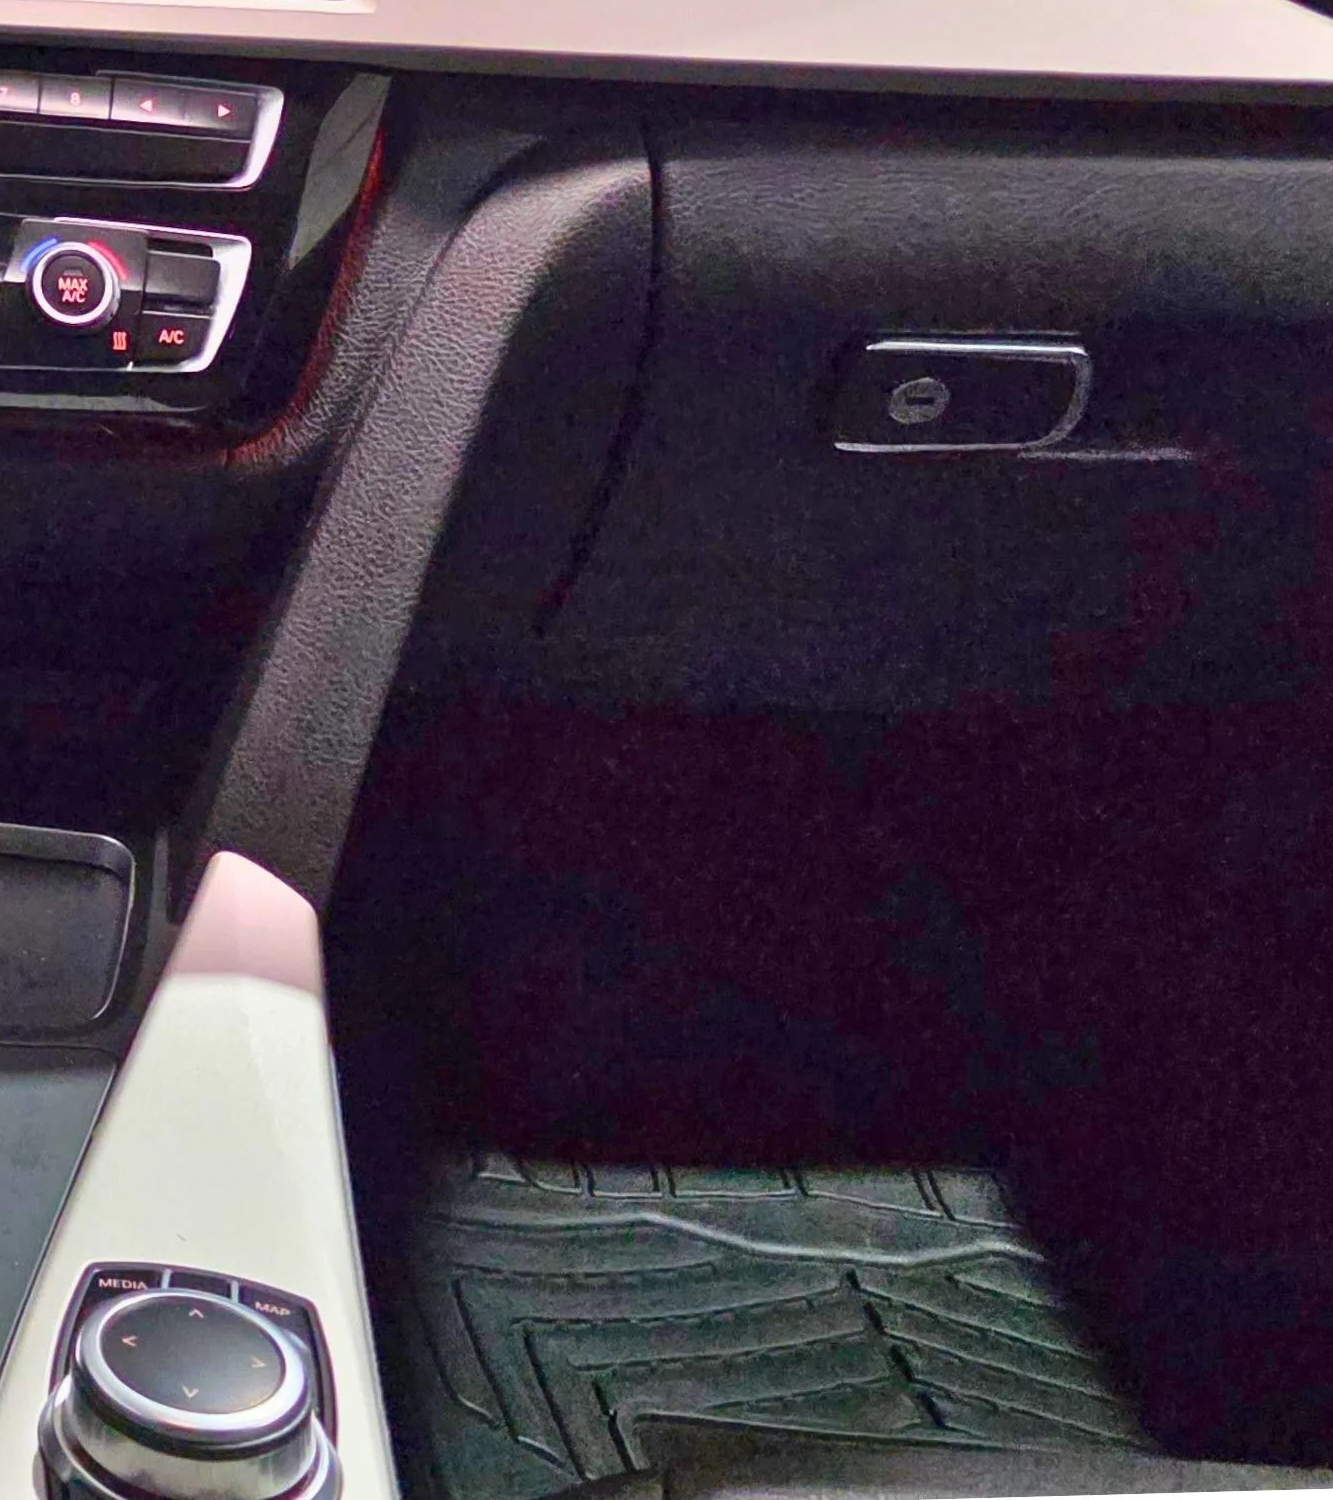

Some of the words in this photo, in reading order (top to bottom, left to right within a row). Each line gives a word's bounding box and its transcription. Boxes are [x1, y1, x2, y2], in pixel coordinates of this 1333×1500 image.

[58, 277, 88, 292] MAX
[62, 291, 86, 303] A/C
[158, 330, 185, 344] A/C
[98, 1278, 149, 1291] MEDIA
[255, 1301, 292, 1317] MAP
